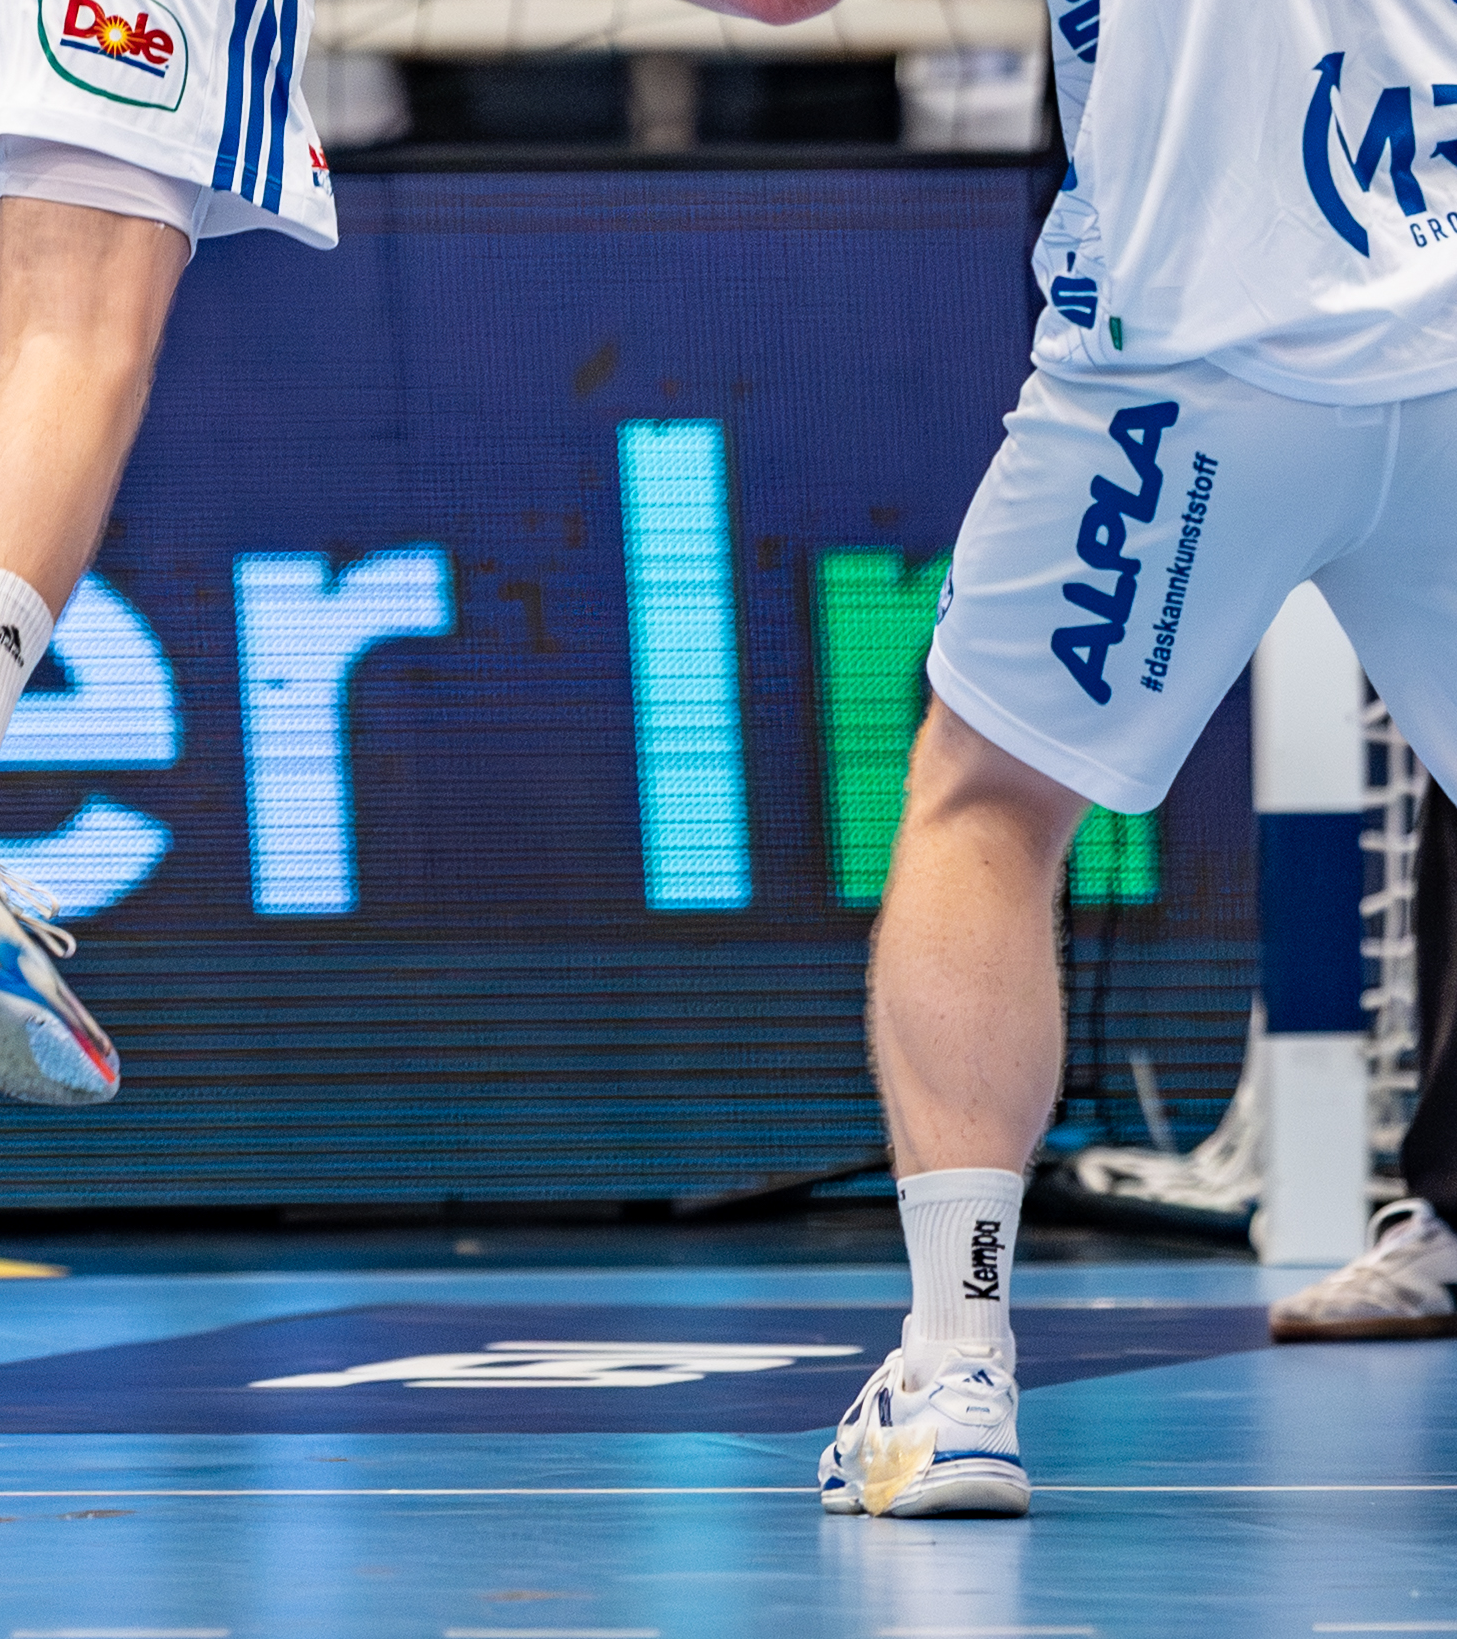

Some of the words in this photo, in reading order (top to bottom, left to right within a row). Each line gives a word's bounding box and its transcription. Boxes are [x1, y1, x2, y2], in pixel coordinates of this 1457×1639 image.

[1051, 401, 1180, 706] ALPLA
[1140, 450, 1219, 694] #daskannkunststoff
[962, 1219, 1006, 1302] Kempa
